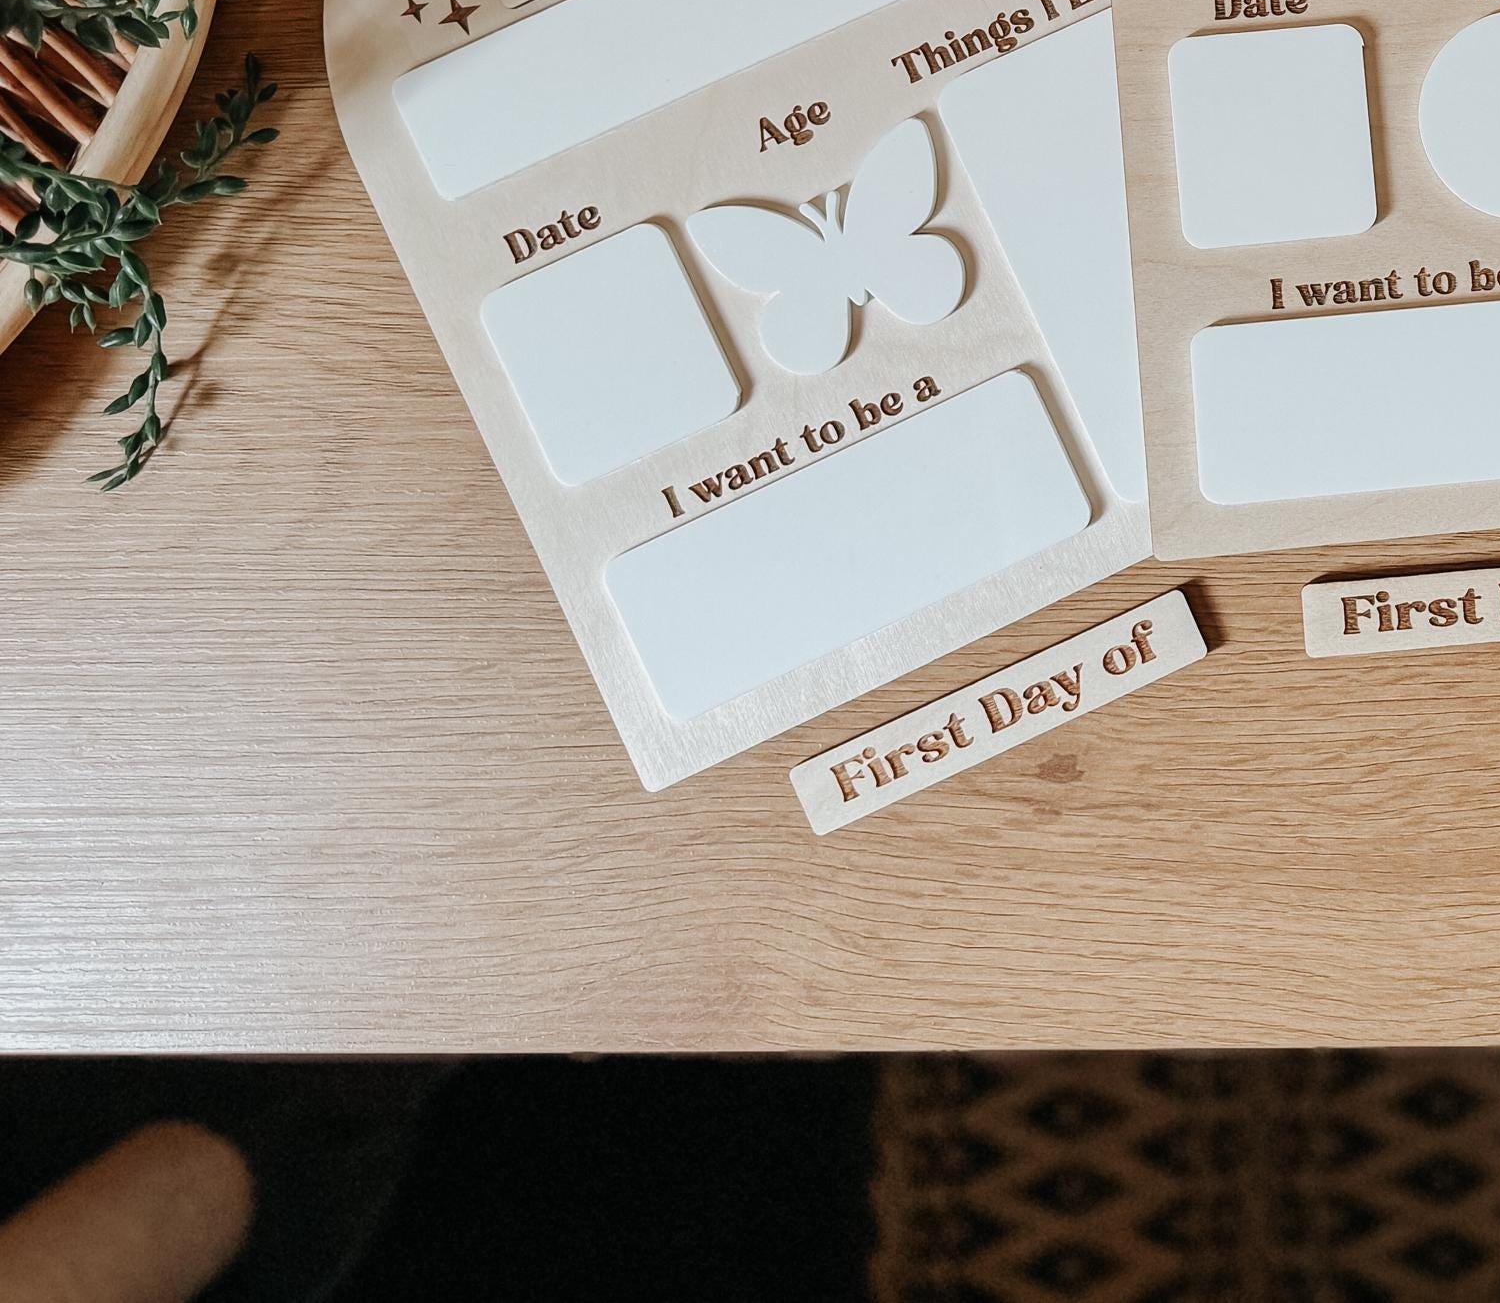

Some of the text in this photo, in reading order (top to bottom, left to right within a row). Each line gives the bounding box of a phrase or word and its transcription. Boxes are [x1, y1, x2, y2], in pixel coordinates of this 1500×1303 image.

[891, 9, 1034, 84] Things
[757, 96, 832, 152] Age
[503, 204, 602, 265] Date
[1270, 278, 1285, 309] I
[1296, 269, 1404, 307] want
[1414, 265, 1458, 296] to
[661, 374, 941, 518] I want to be a
[1341, 587, 1485, 635] First
[829, 620, 1157, 804] First Day of
